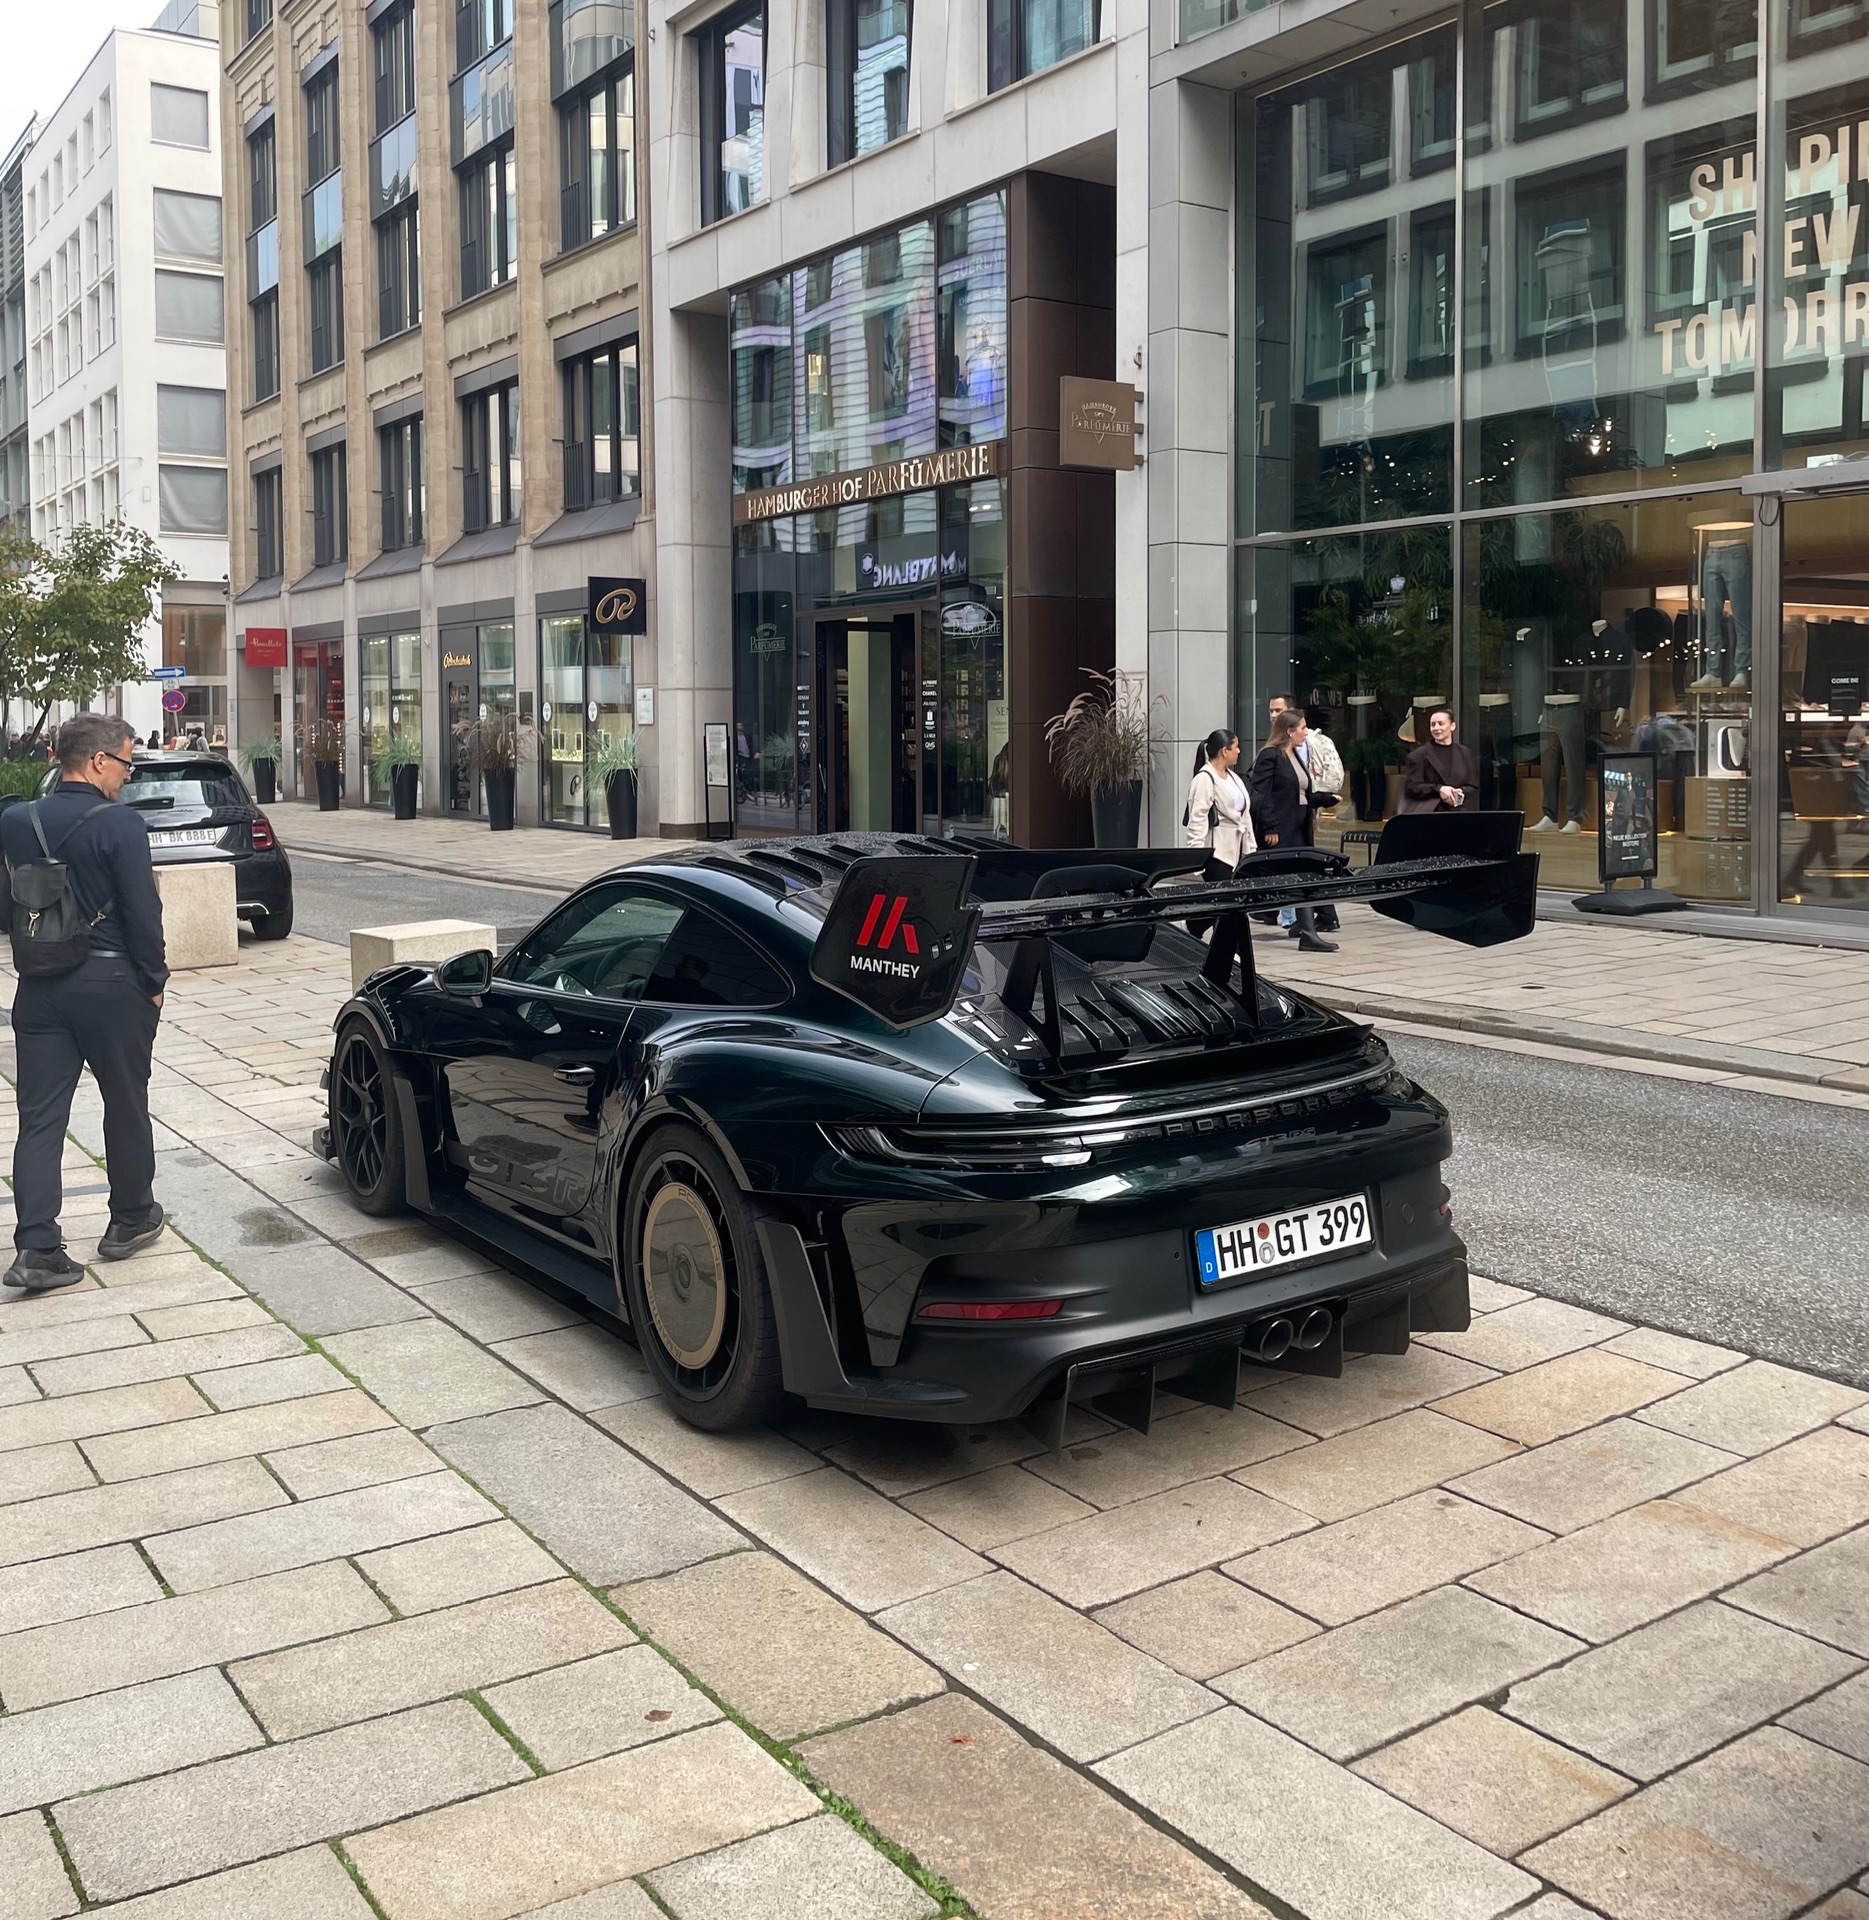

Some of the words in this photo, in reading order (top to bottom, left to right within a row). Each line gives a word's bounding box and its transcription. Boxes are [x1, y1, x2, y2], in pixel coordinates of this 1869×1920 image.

[748, 485, 829, 519] HAMBURGER
[833, 477, 863, 503] HOF
[866, 445, 990, 497] PARFÜMERIE
[169, 831, 184, 843] BK
[851, 955, 920, 979] MANTHEY
[1166, 1091, 1344, 1136] PORSCHE
[1217, 1227, 1258, 1271] HH
[1275, 1214, 1309, 1256] GT
[1317, 1202, 1365, 1246] 399
[1206, 1262, 1213, 1273] D
